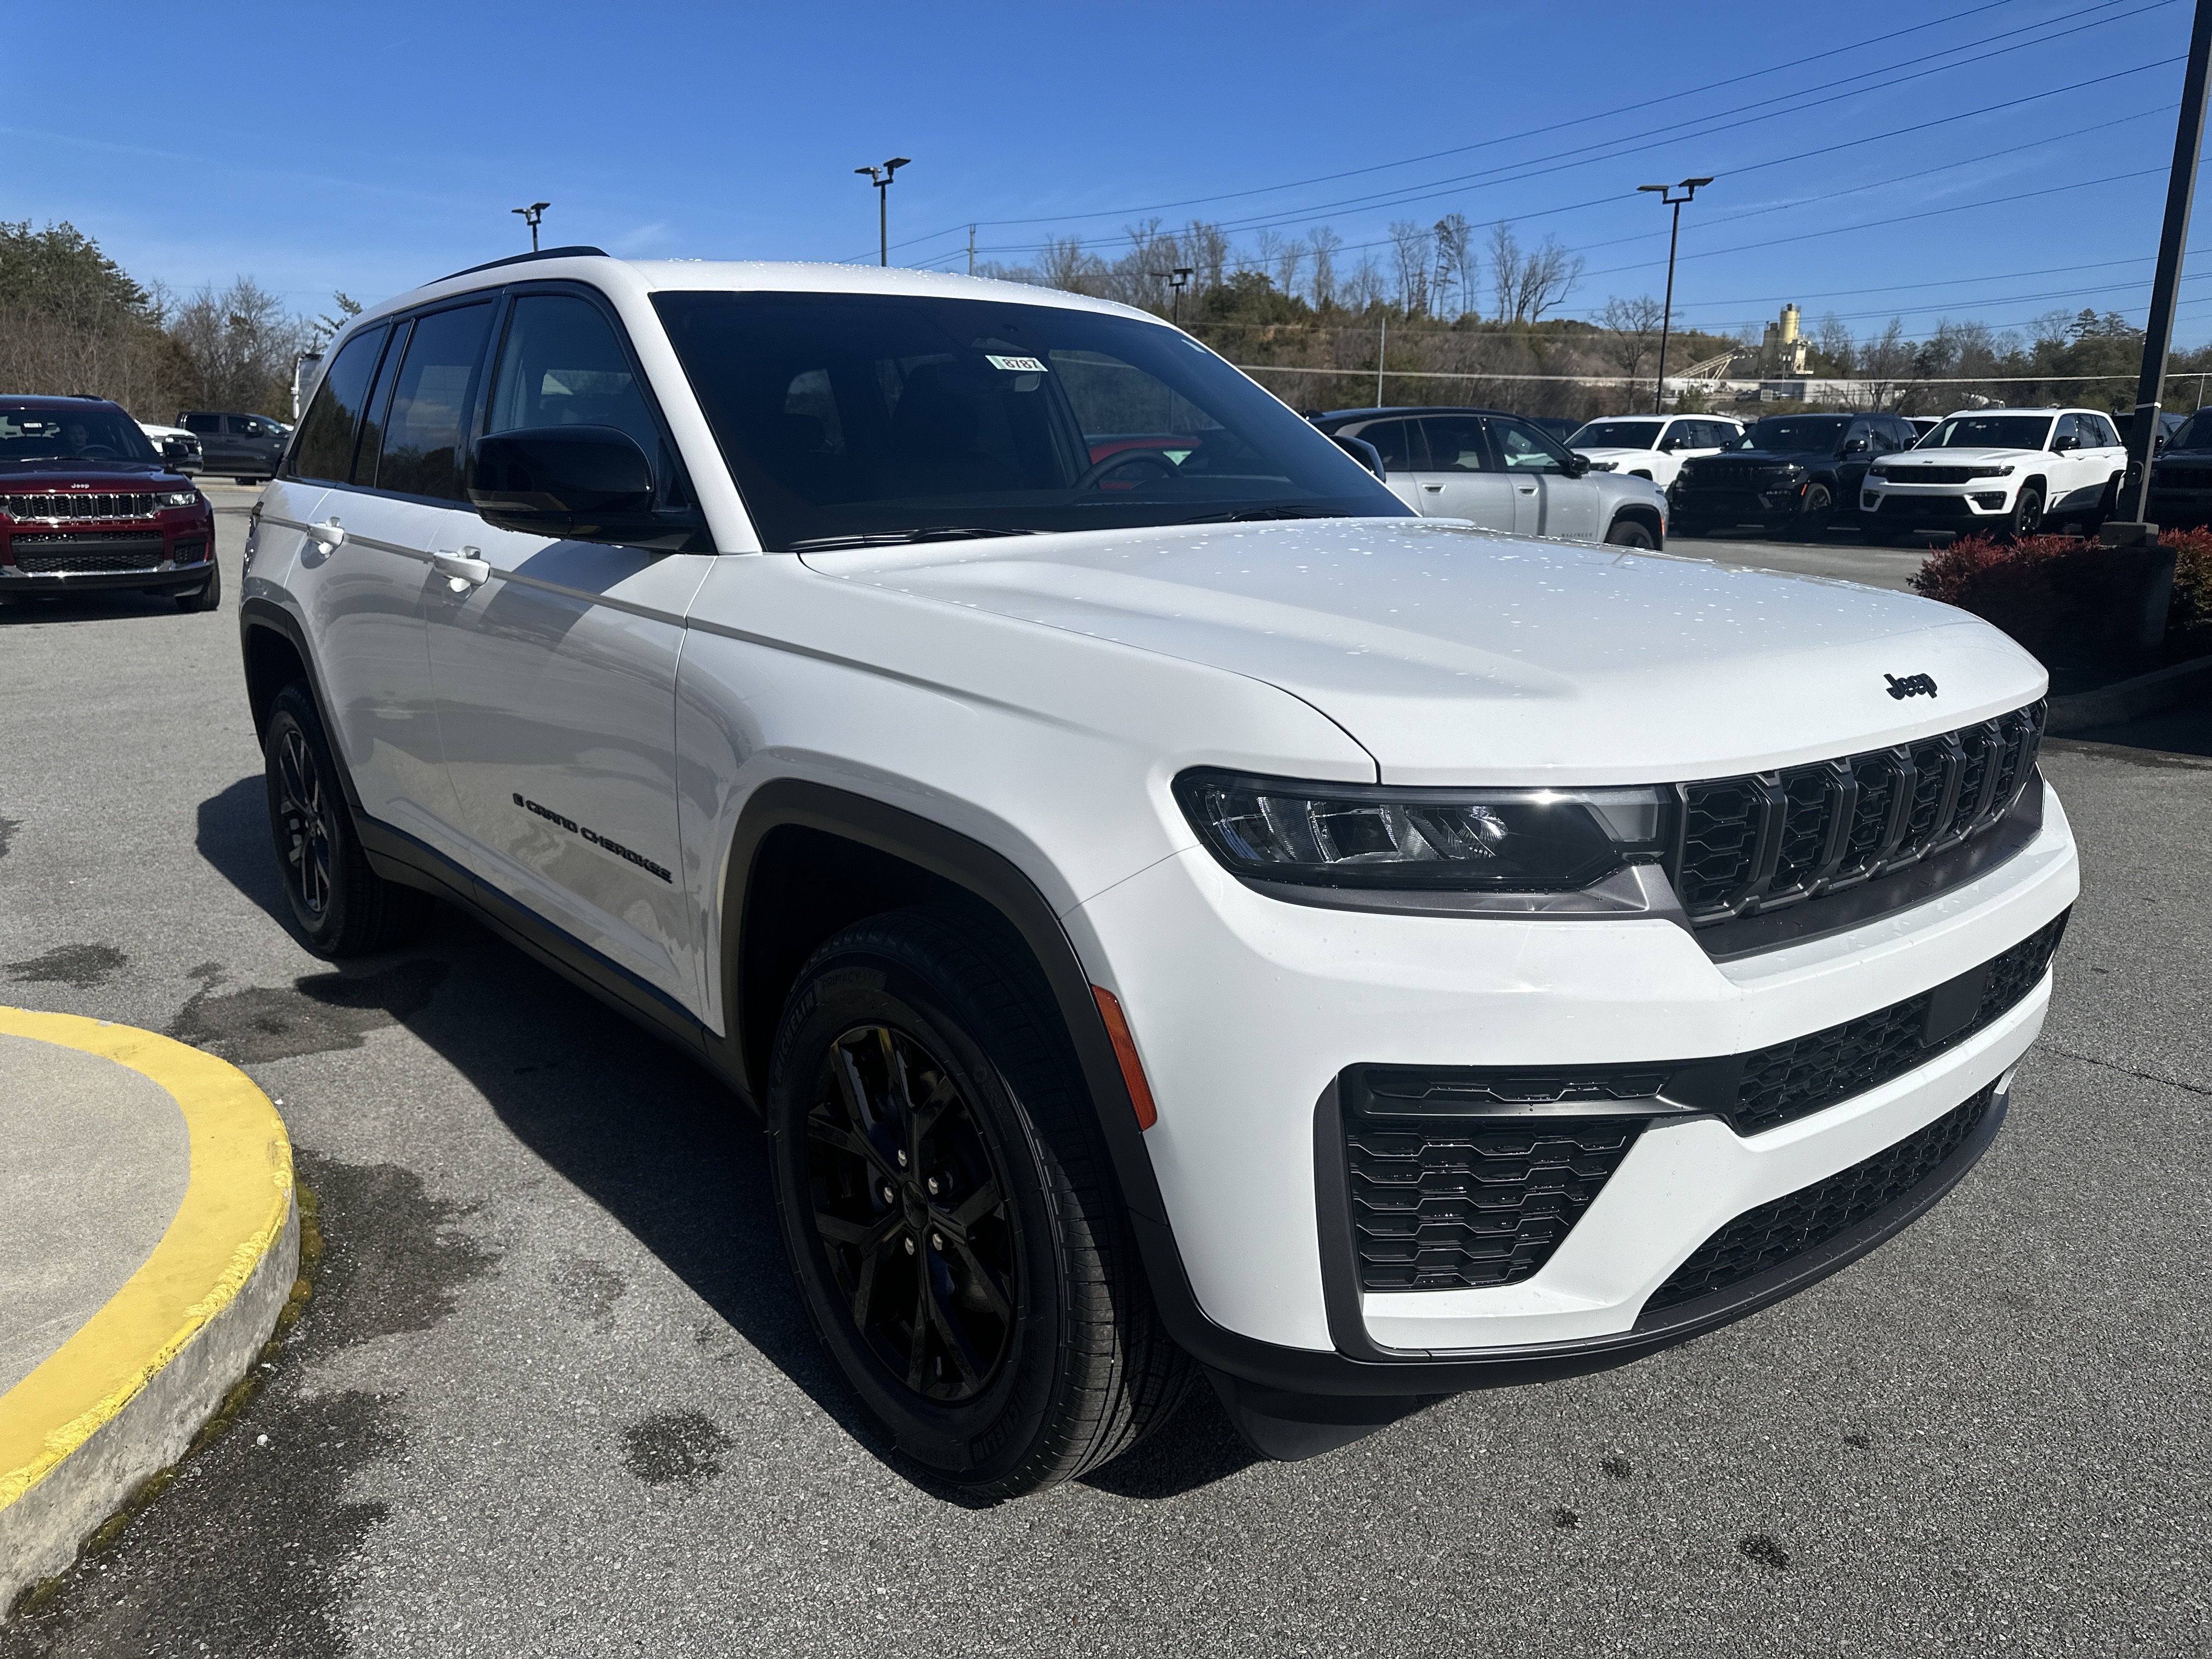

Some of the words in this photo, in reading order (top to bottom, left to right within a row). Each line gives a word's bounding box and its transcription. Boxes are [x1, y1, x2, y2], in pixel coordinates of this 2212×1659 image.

[1002, 359, 1039, 369] 8787
[1883, 673, 1937, 700] Jeep
[526, 799, 578, 833] GRAND
[580, 827, 673, 884] CHEROKEE
[822, 971, 860, 988] PRIMACY
[774, 991, 815, 1084] MICHELIN
